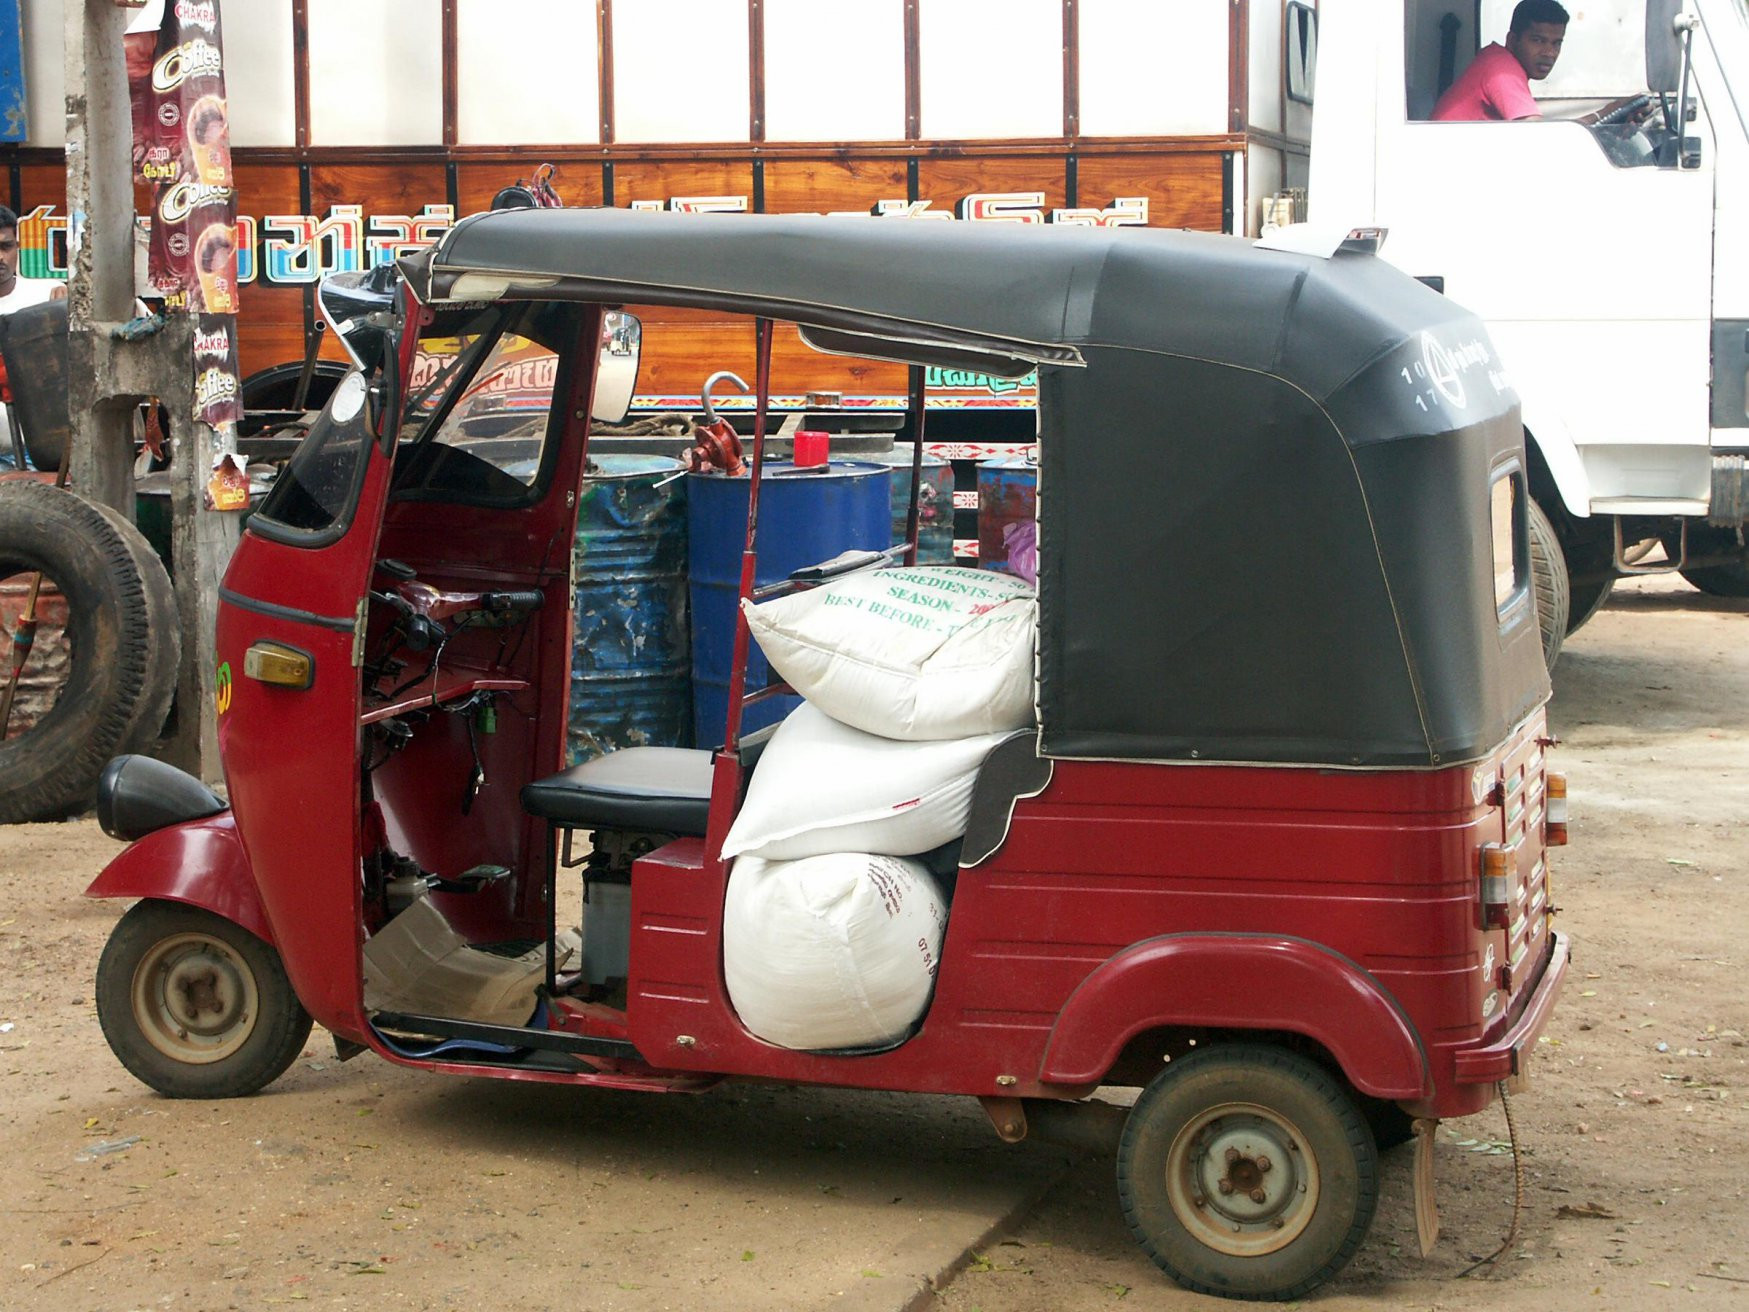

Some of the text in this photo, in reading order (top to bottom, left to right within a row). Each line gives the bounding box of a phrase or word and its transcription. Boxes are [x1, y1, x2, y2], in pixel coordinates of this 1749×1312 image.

[174, 4, 217, 21] CHAKRA
[152, 38, 220, 93] Coffee
[824, 593, 863, 609] BEST
[868, 600, 936, 632] BEFORE
[887, 586, 953, 613] SEASON
